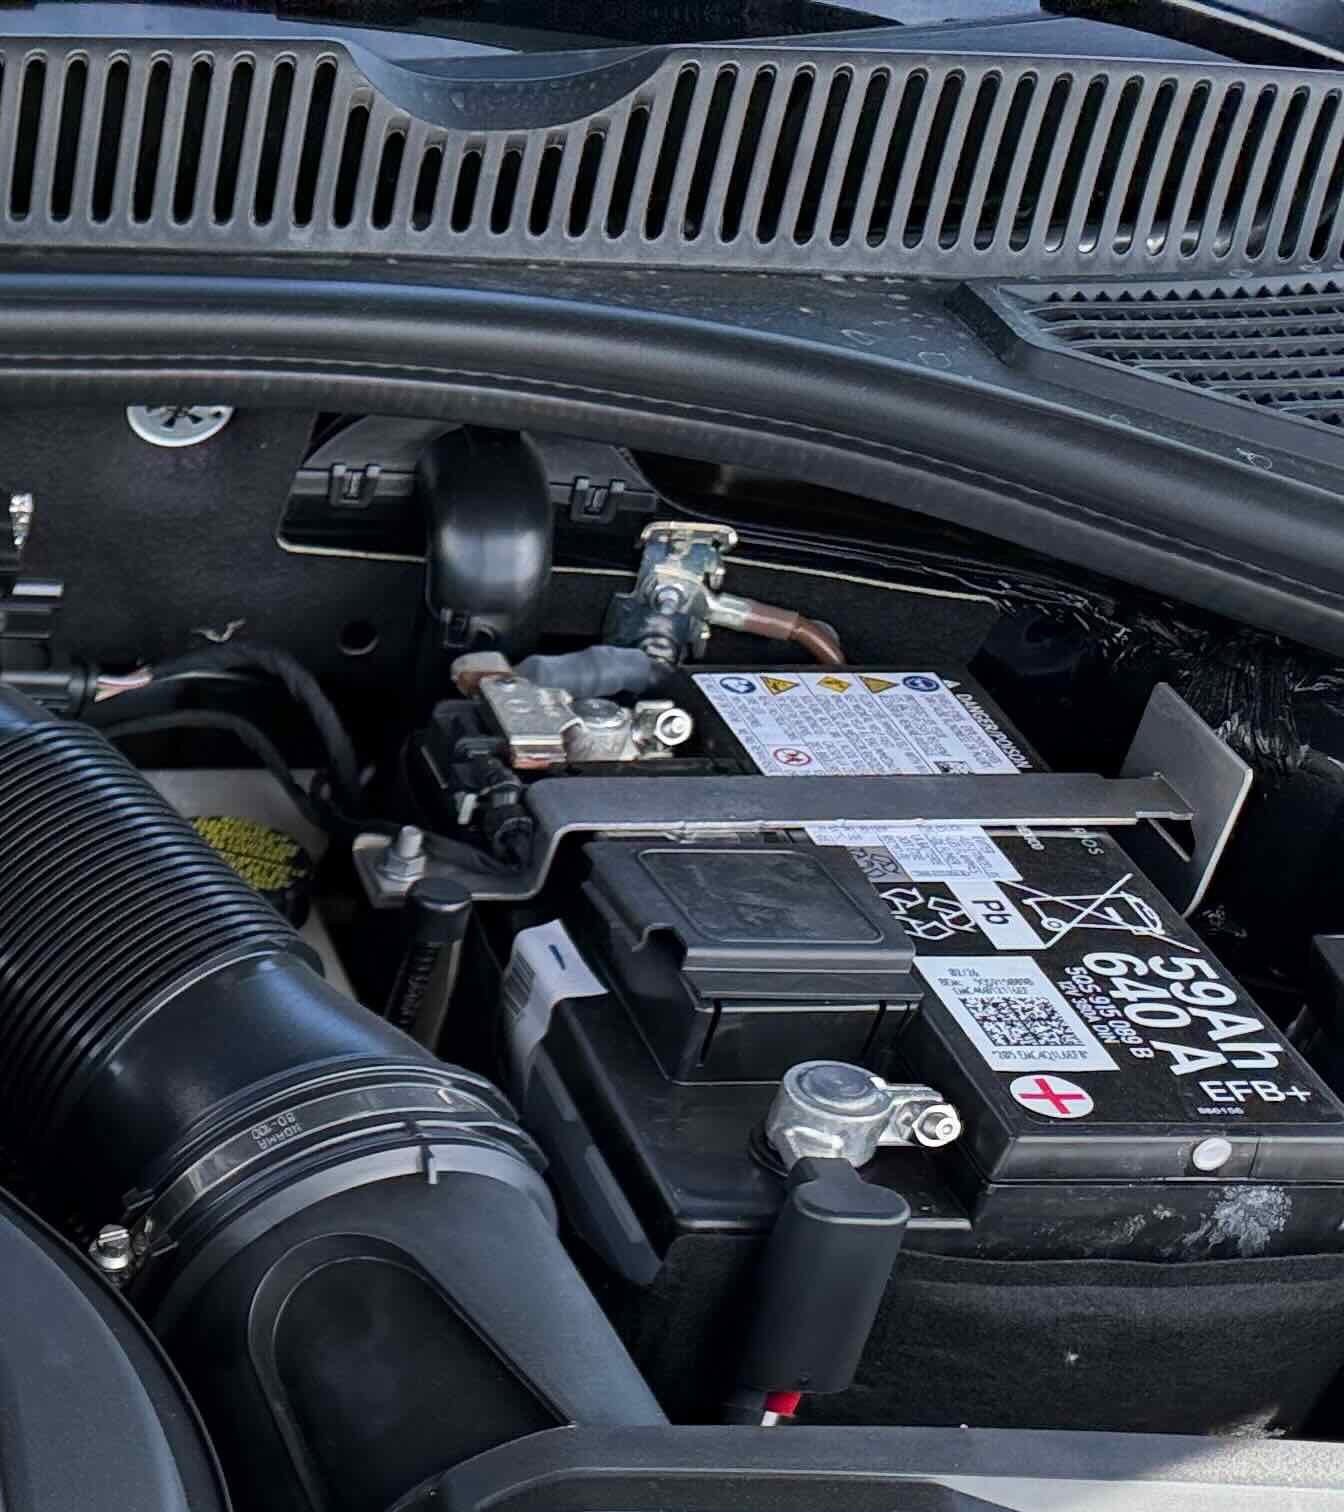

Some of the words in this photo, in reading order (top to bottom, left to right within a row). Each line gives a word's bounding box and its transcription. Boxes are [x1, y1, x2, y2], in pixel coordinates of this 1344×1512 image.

[972, 899, 1014, 925] Pb
[1083, 952, 1191, 1029] 640
[1150, 1040, 1228, 1076] A
[1089, 995, 1122, 1018] 915
[1108, 1020, 1144, 1045] 089
[1129, 1047, 1154, 1058] B
[1149, 955, 1285, 1069] 59Ah
[1198, 1080, 1311, 1102] EFB+
